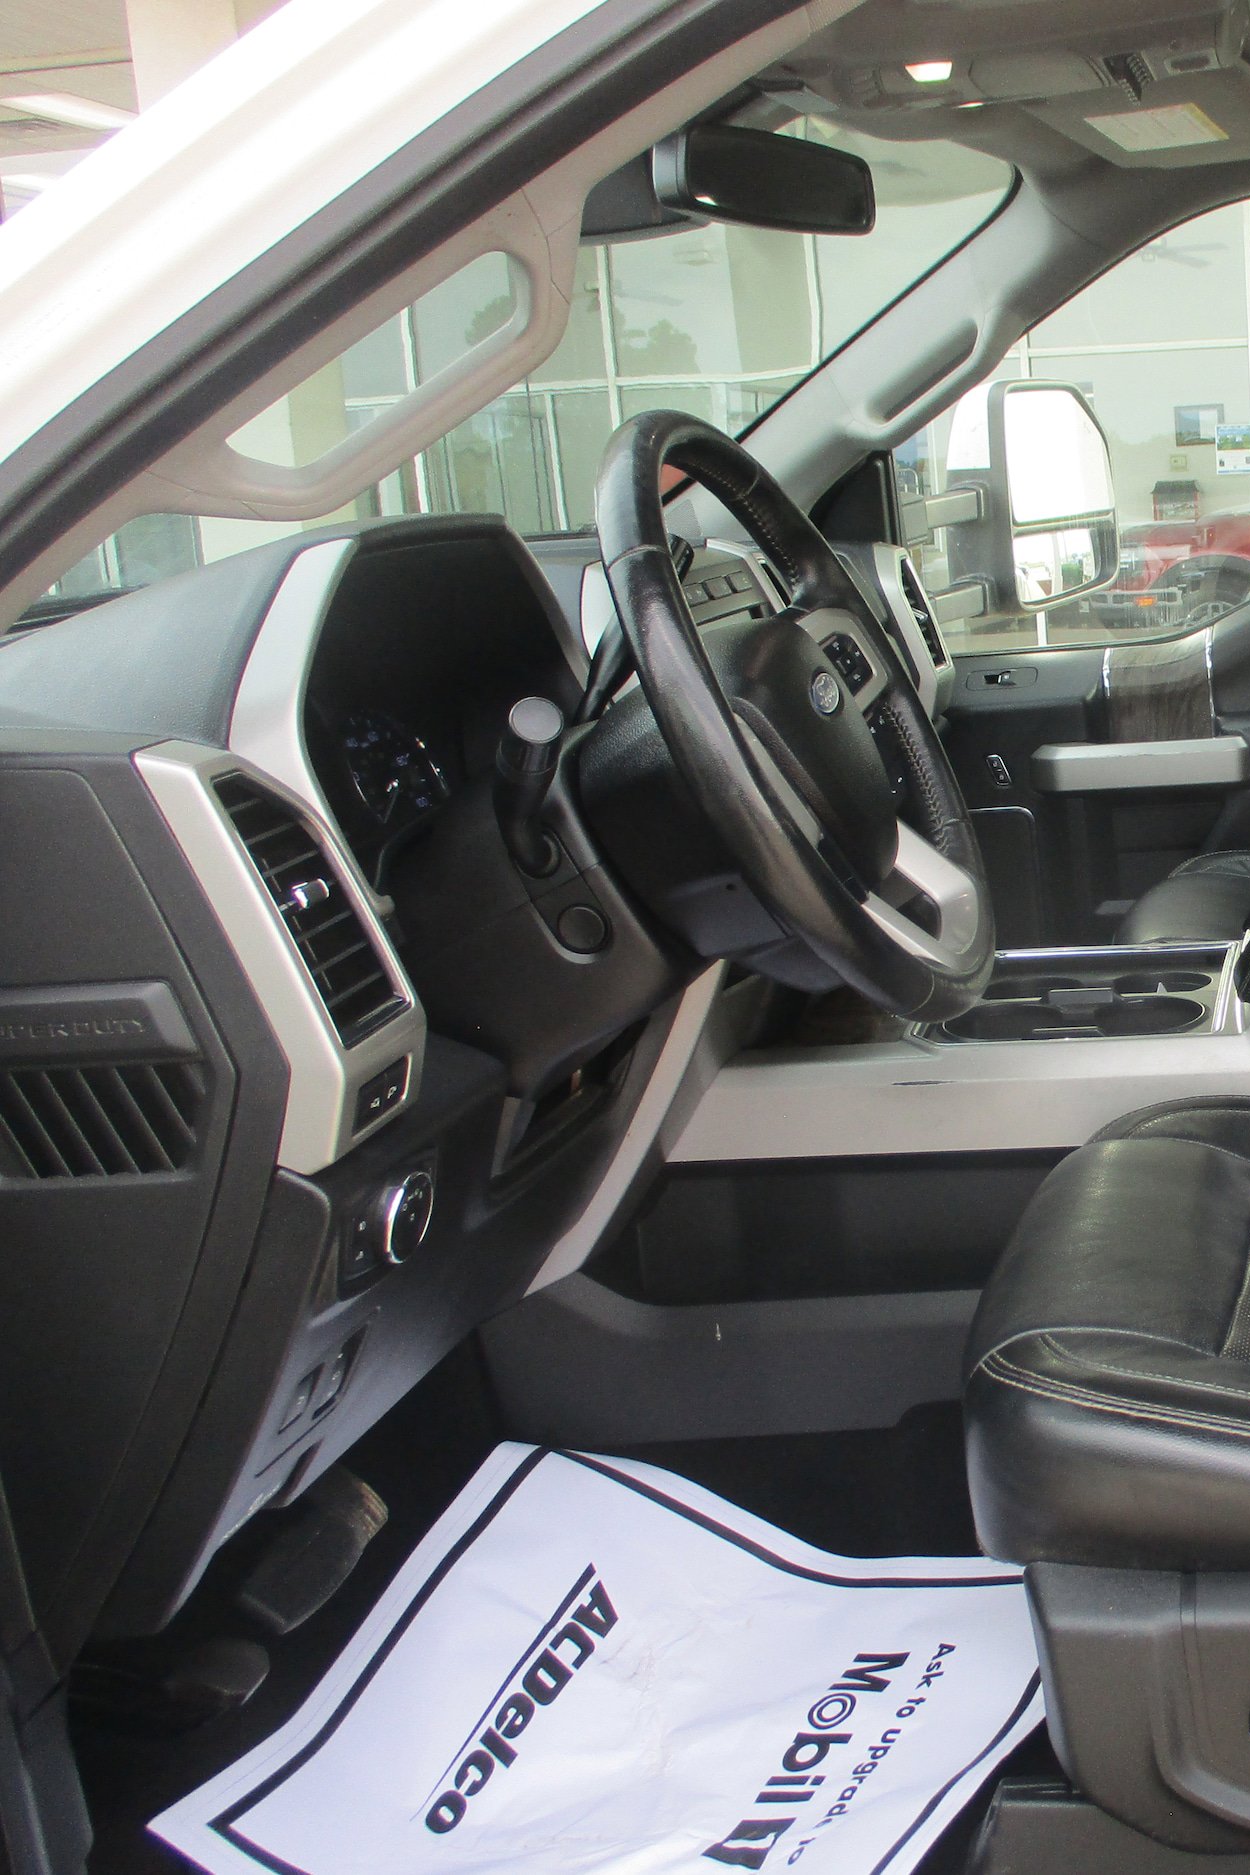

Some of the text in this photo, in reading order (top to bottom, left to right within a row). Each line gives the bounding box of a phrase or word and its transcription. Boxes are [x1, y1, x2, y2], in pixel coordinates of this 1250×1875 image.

[424, 1578, 619, 1834] ACDelco
[895, 1696, 927, 1718] to
[915, 1643, 957, 1690] Ask
[753, 1651, 911, 1804] Mobil
